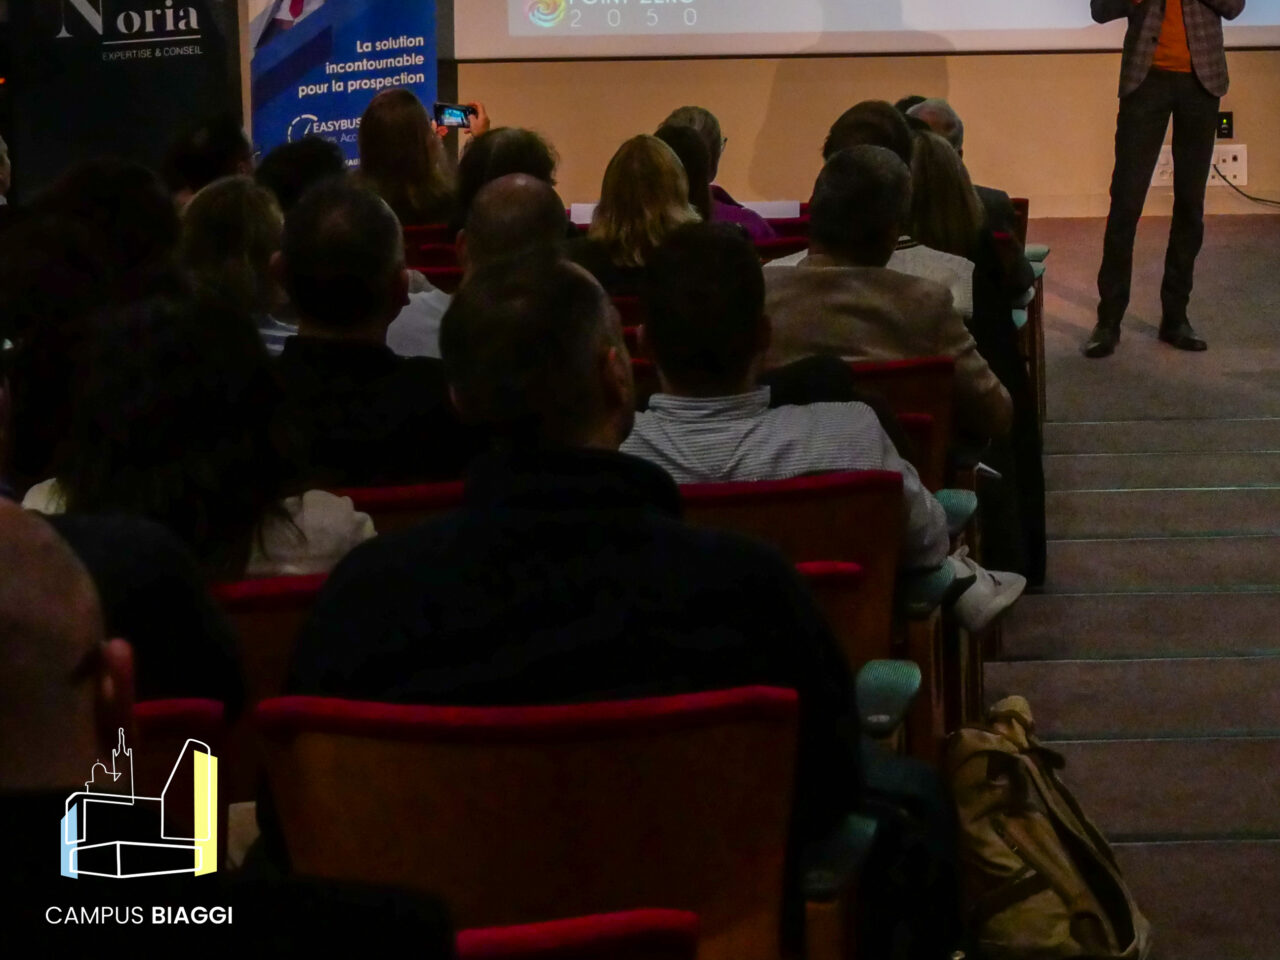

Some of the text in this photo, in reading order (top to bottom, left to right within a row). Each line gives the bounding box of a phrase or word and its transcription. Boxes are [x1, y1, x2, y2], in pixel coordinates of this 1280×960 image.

[102, 45, 202, 61] EXPERTISE & CONSEIL
[356, 36, 424, 52] La solution
[326, 53, 424, 74] incontournable
[298, 72, 424, 99] pour la prospection
